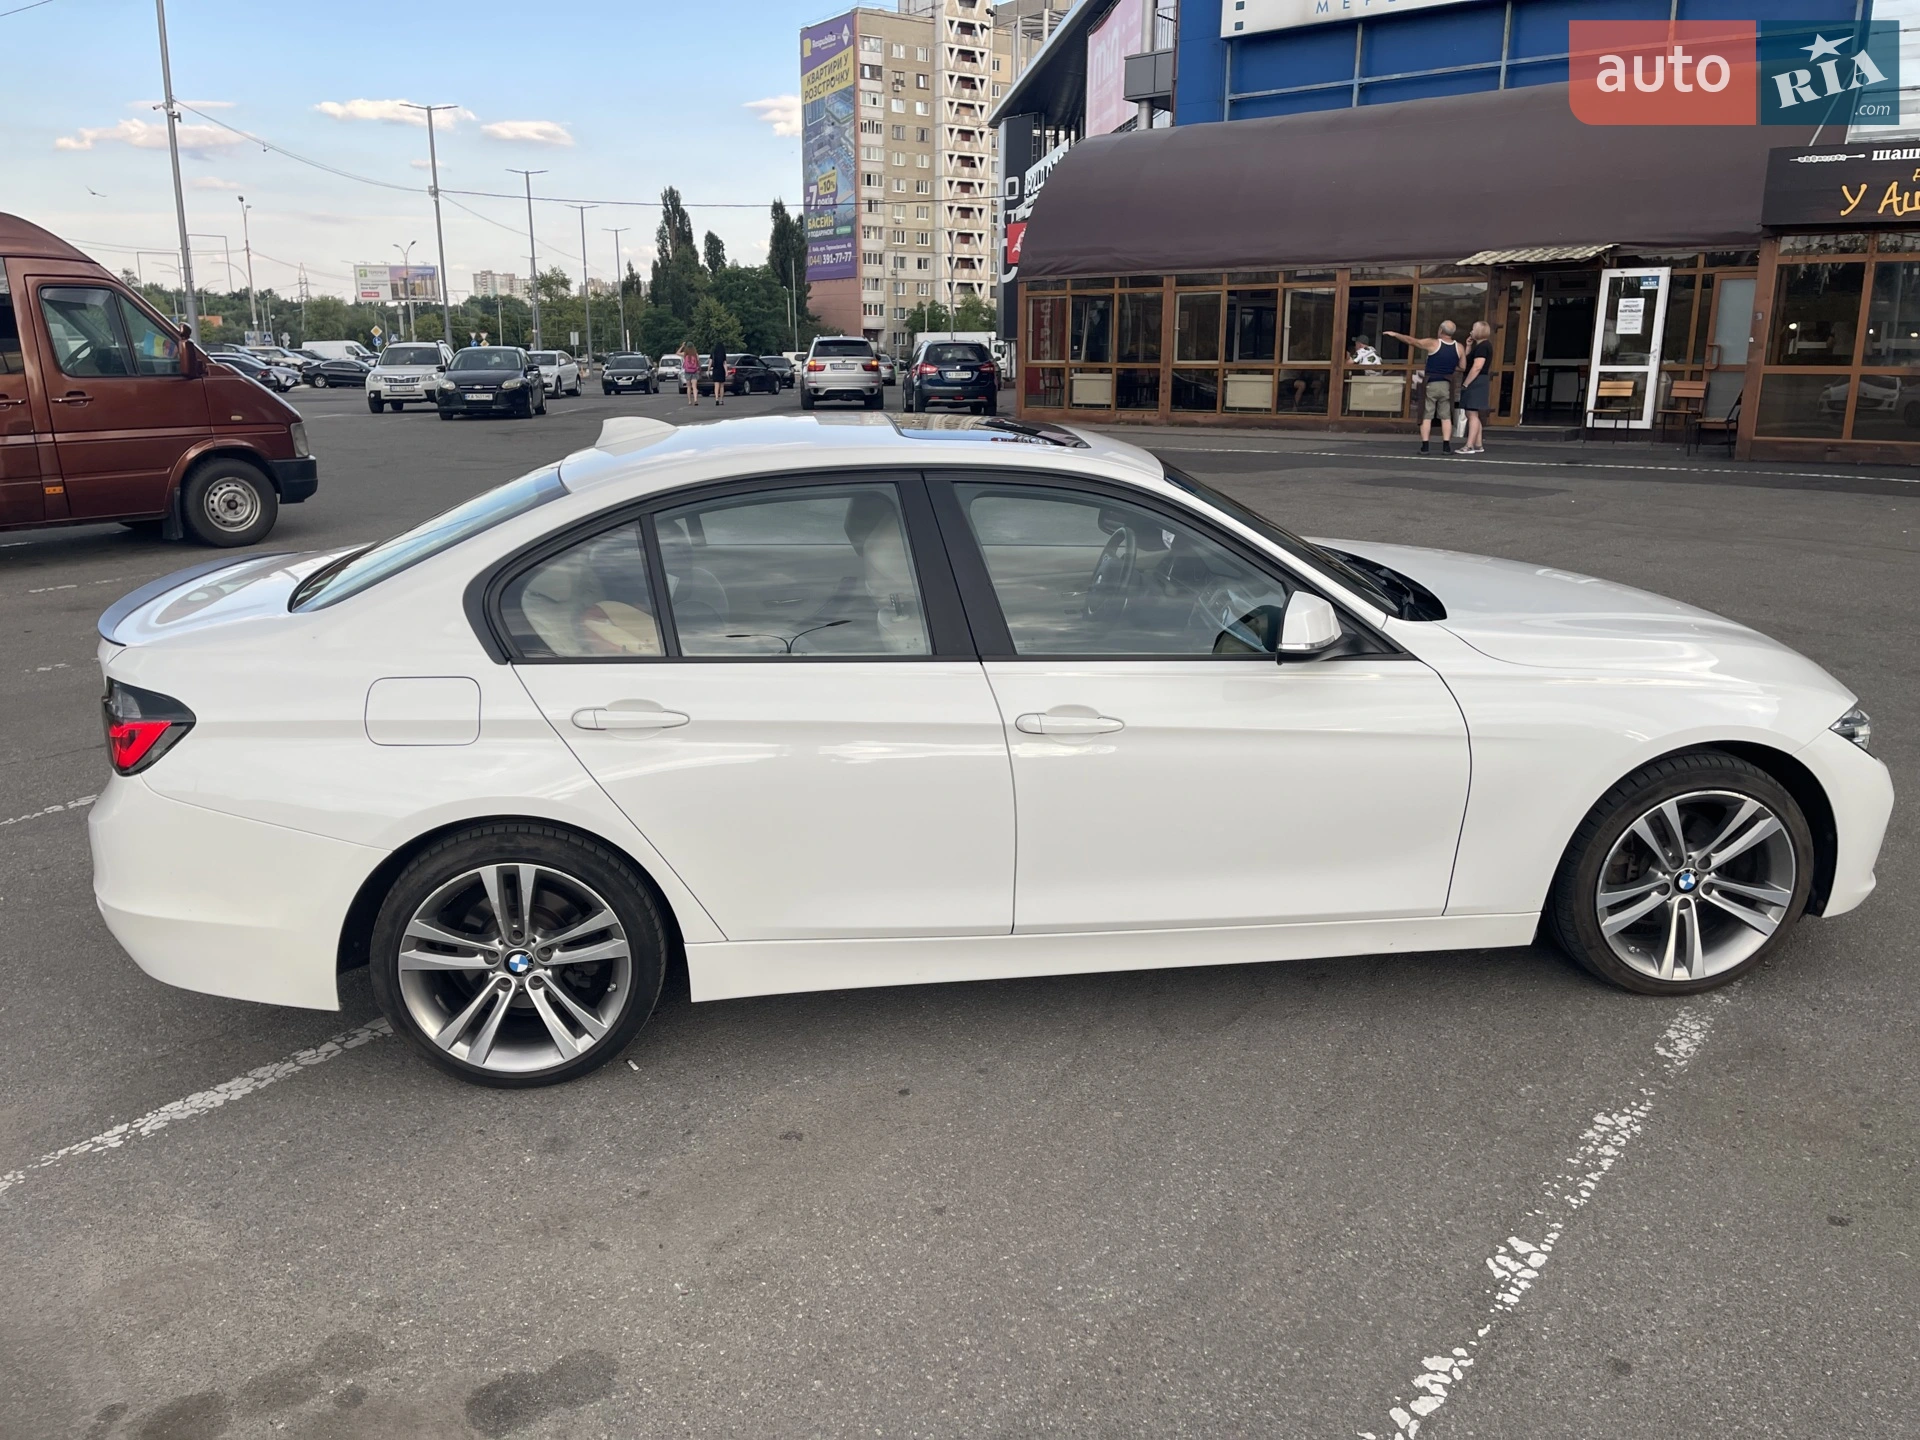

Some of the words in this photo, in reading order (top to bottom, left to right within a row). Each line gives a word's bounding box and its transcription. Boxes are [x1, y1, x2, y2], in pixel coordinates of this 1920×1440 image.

[804, 67, 850, 102] РОЗСТРОЧКУ
[806, 56, 843, 86] КВАРТИРИ
[809, 184, 818, 211] 7
[1840, 183, 1868, 216] У
[808, 214, 834, 230] БАСЕЙН
[822, 251, 852, 264] 391-77-77
